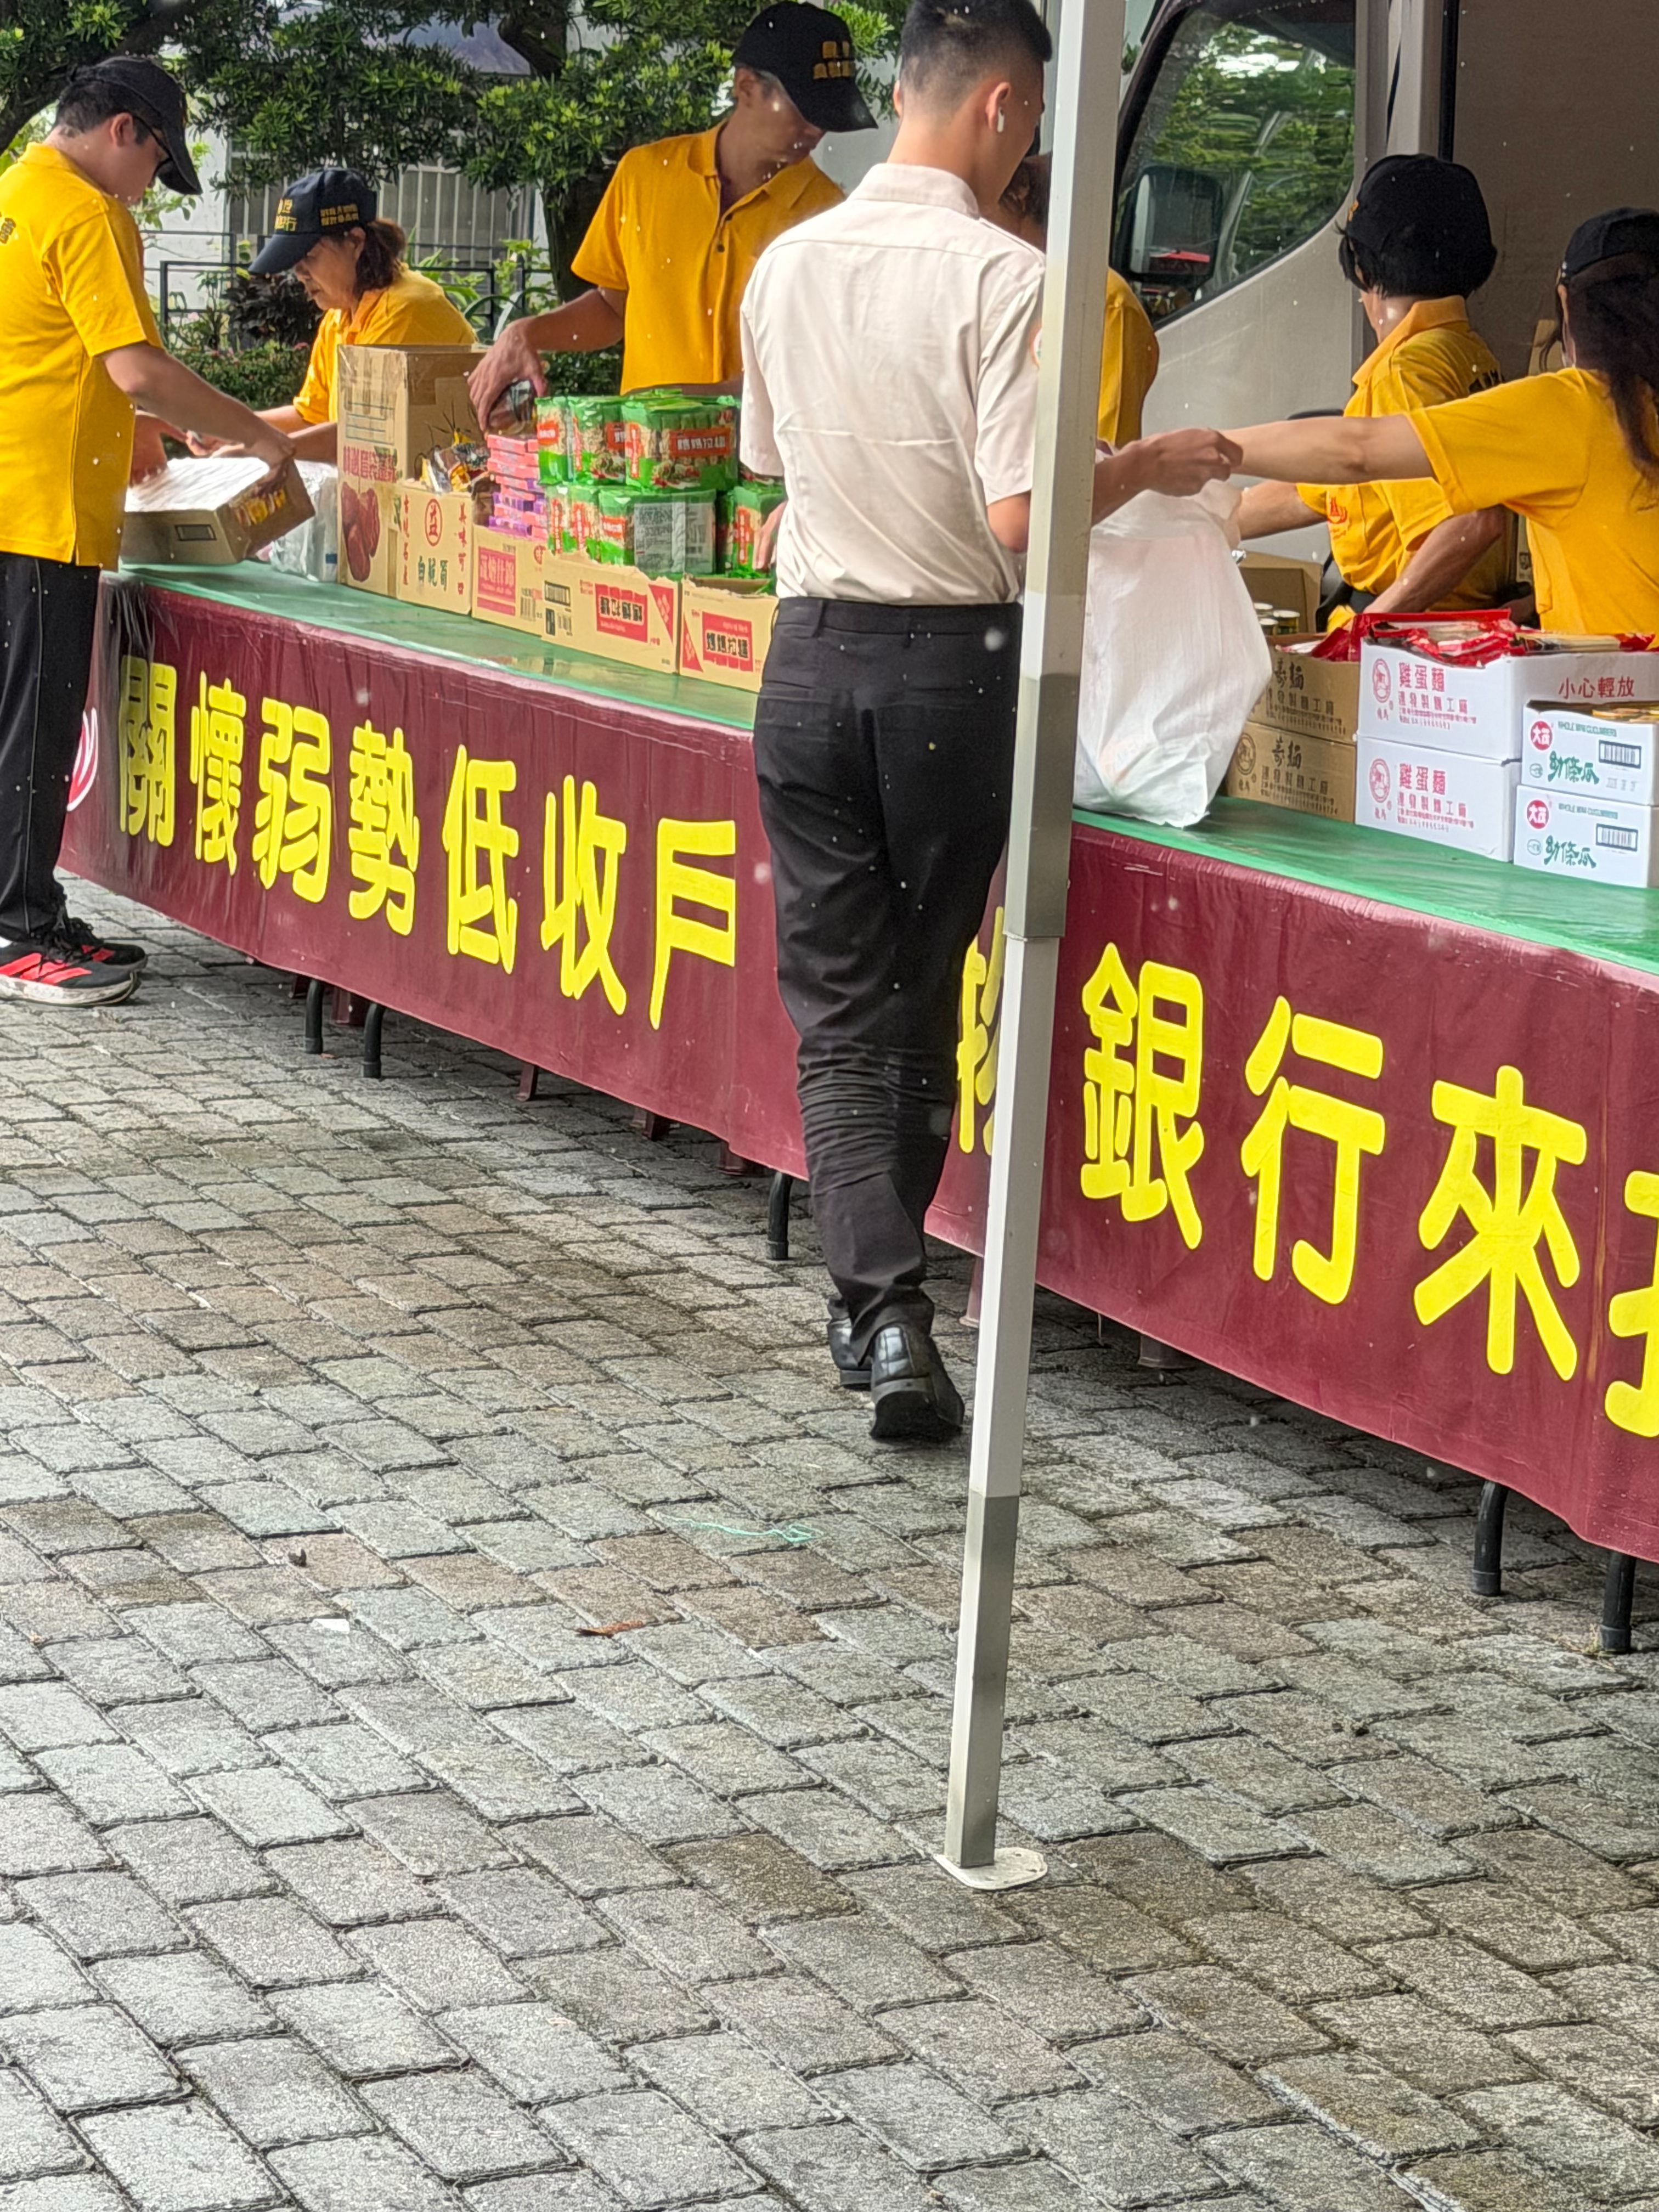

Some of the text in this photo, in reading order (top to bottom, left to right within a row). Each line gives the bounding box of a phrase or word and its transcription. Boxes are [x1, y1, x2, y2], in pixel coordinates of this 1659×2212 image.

[458, 503, 467, 594] 美味可口
[1559, 676, 1635, 699] 小心輕放
[119, 655, 737, 1030] 關懷弱勢低收戶
